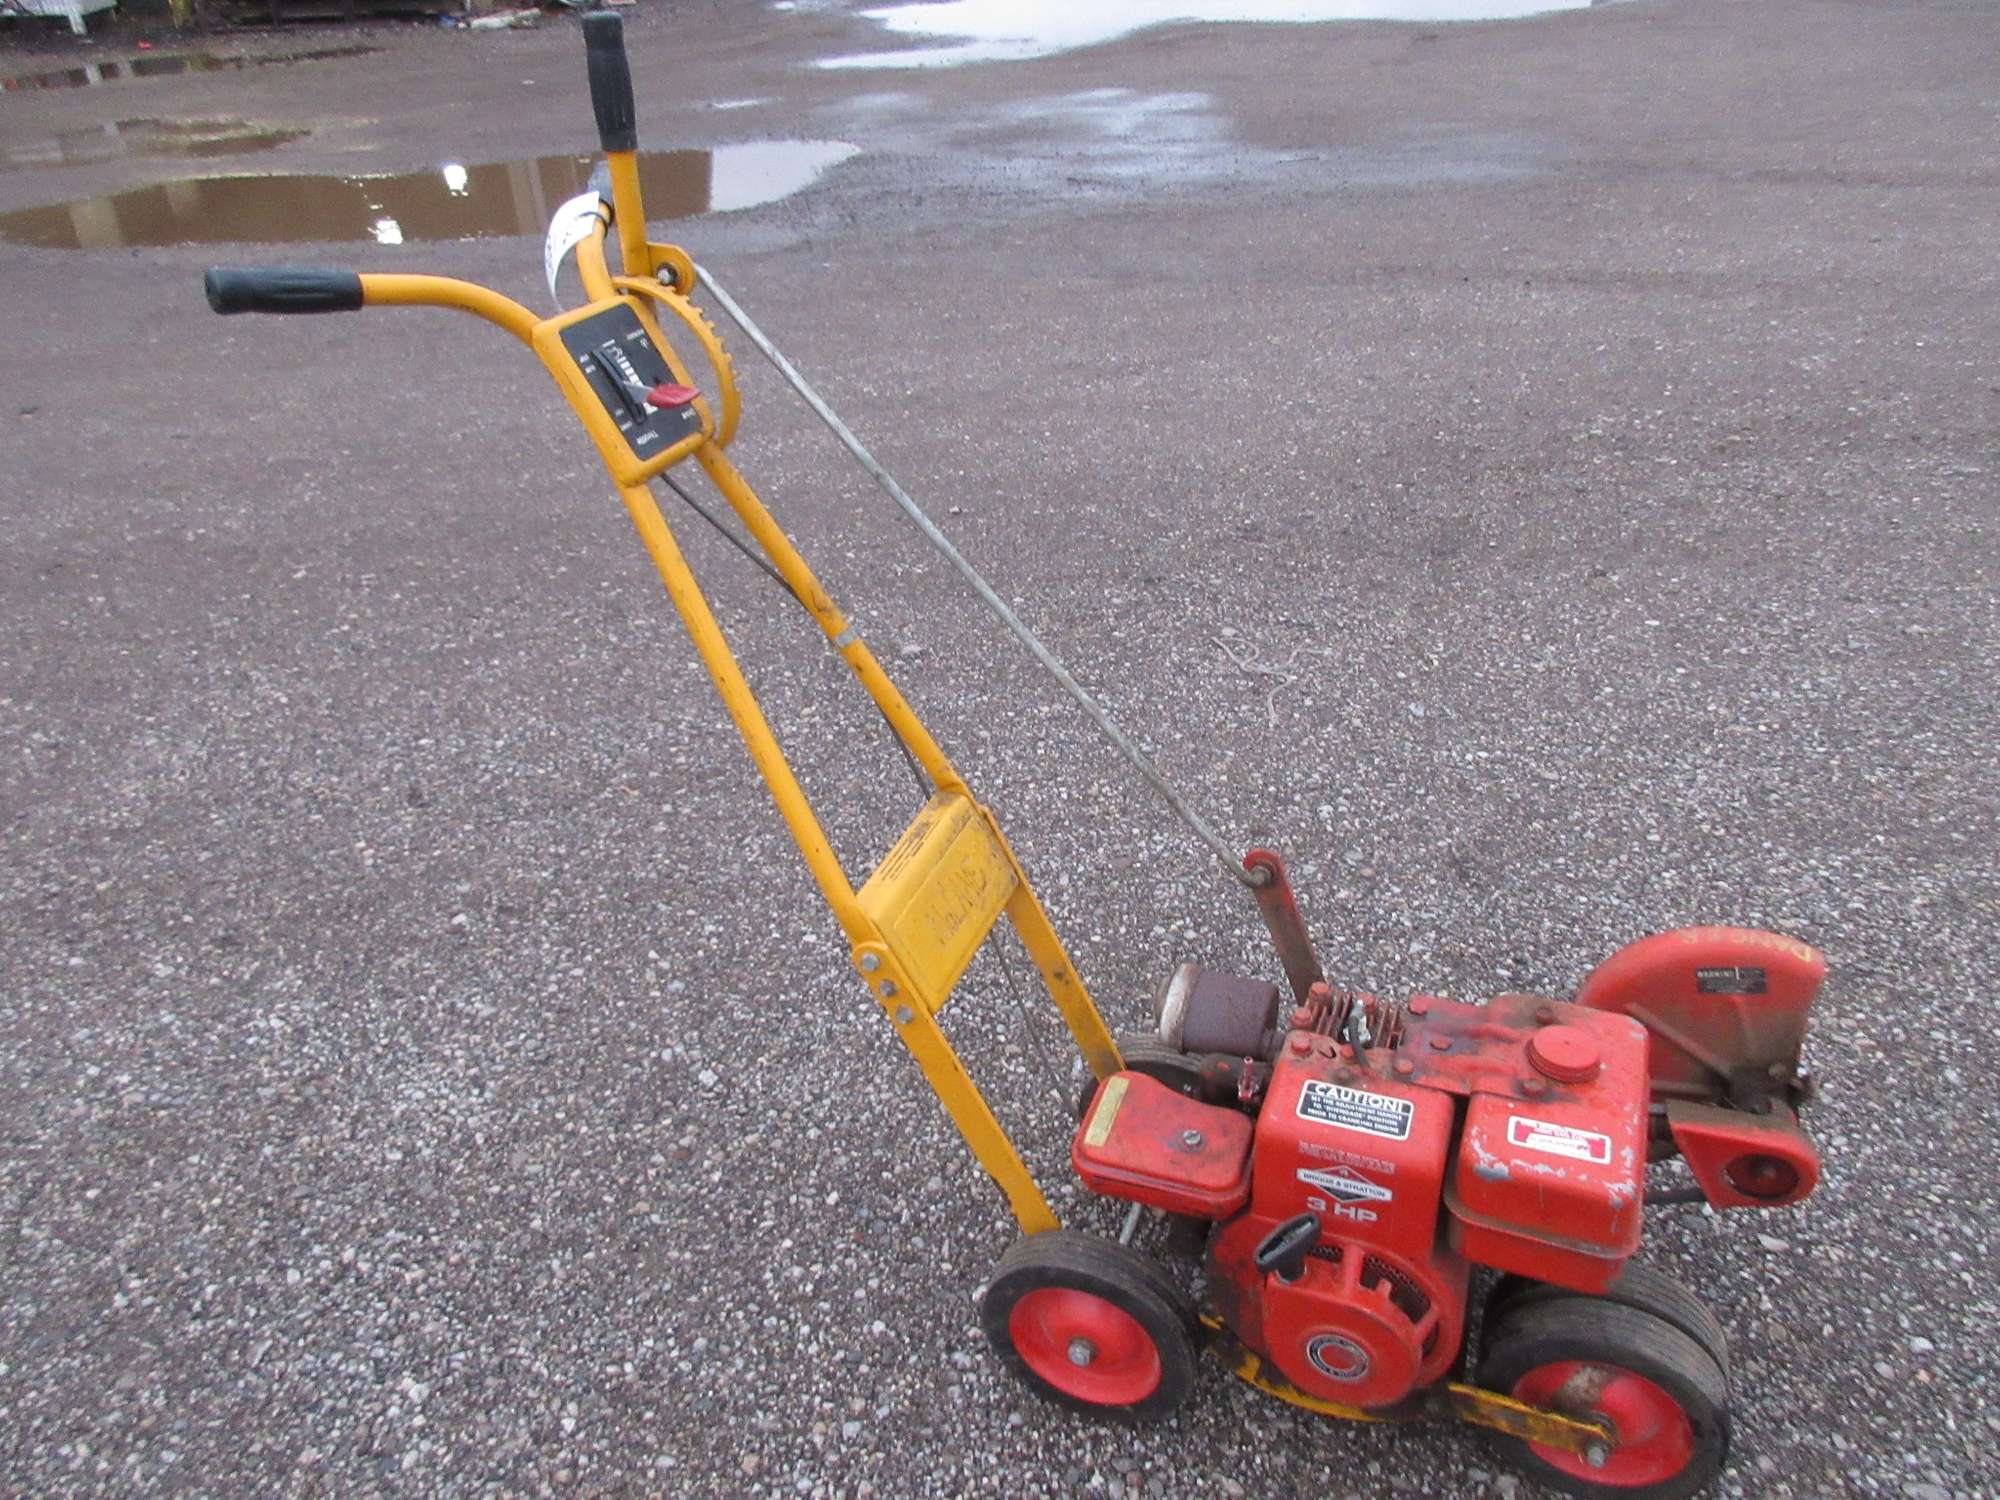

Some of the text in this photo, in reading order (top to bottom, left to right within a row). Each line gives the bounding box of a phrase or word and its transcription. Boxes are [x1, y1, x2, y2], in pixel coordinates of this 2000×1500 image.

[1314, 1083, 1404, 1114] CAUTION!
[1303, 1172, 1335, 1185] BRIGGS
[1343, 1181, 1386, 1198] STRATTON
[1306, 1196, 1378, 1221] 3 HP
